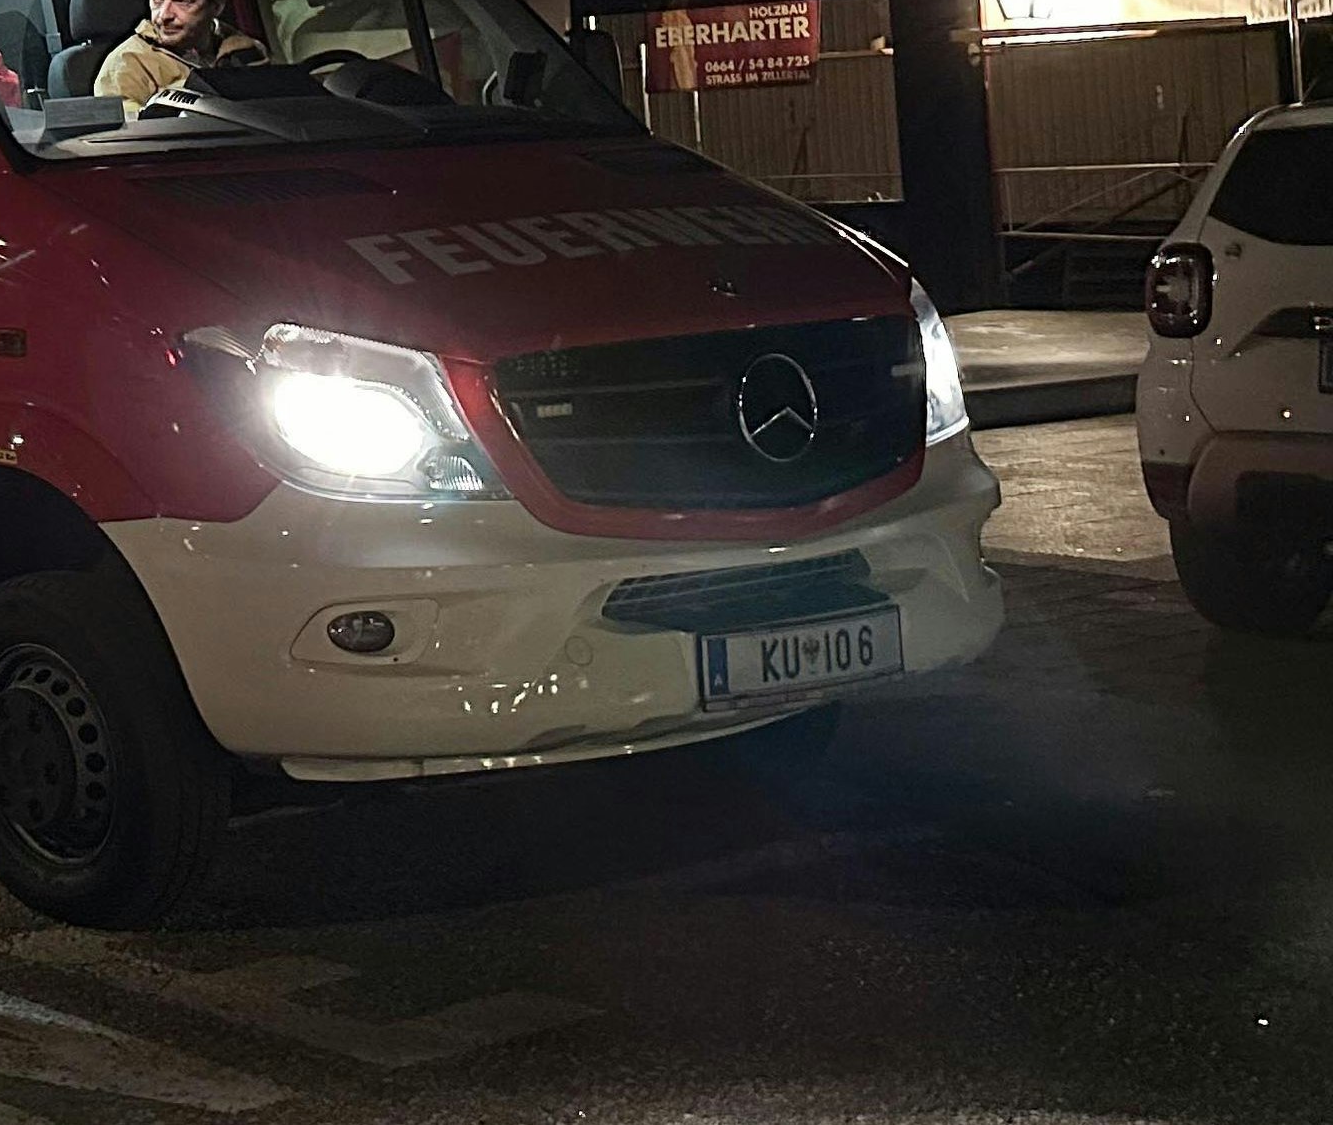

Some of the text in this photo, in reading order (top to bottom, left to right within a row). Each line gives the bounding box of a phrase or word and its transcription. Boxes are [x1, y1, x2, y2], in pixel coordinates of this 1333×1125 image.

[749, 2, 808, 18] HOLZBAU
[655, 16, 811, 48] EBERHARTER
[704, 59, 735, 73] 0664
[761, 636, 801, 683] KU
